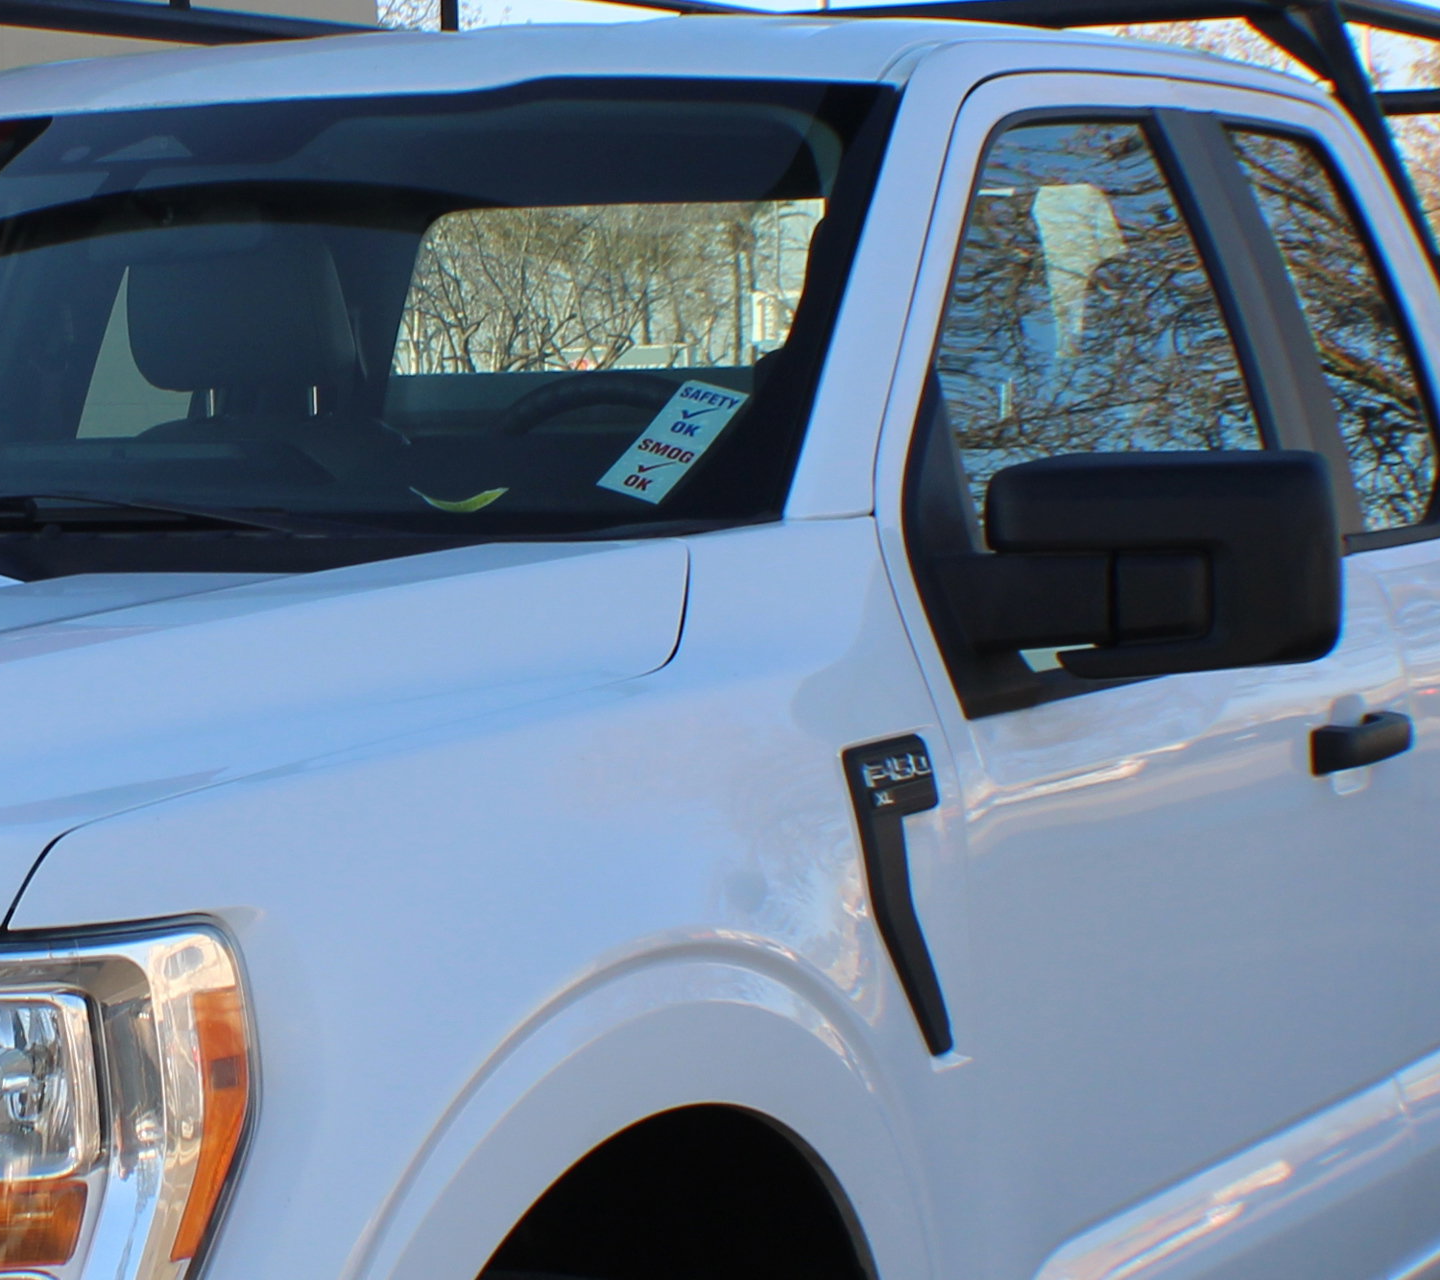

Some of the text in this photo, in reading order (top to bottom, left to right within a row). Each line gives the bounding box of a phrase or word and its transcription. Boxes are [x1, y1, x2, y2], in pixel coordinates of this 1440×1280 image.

[679, 386, 740, 410] SAFETY
[670, 420, 700, 437] OK
[637, 438, 695, 464] SMOG
[623, 474, 653, 491] OK
[874, 791, 895, 807] XL
